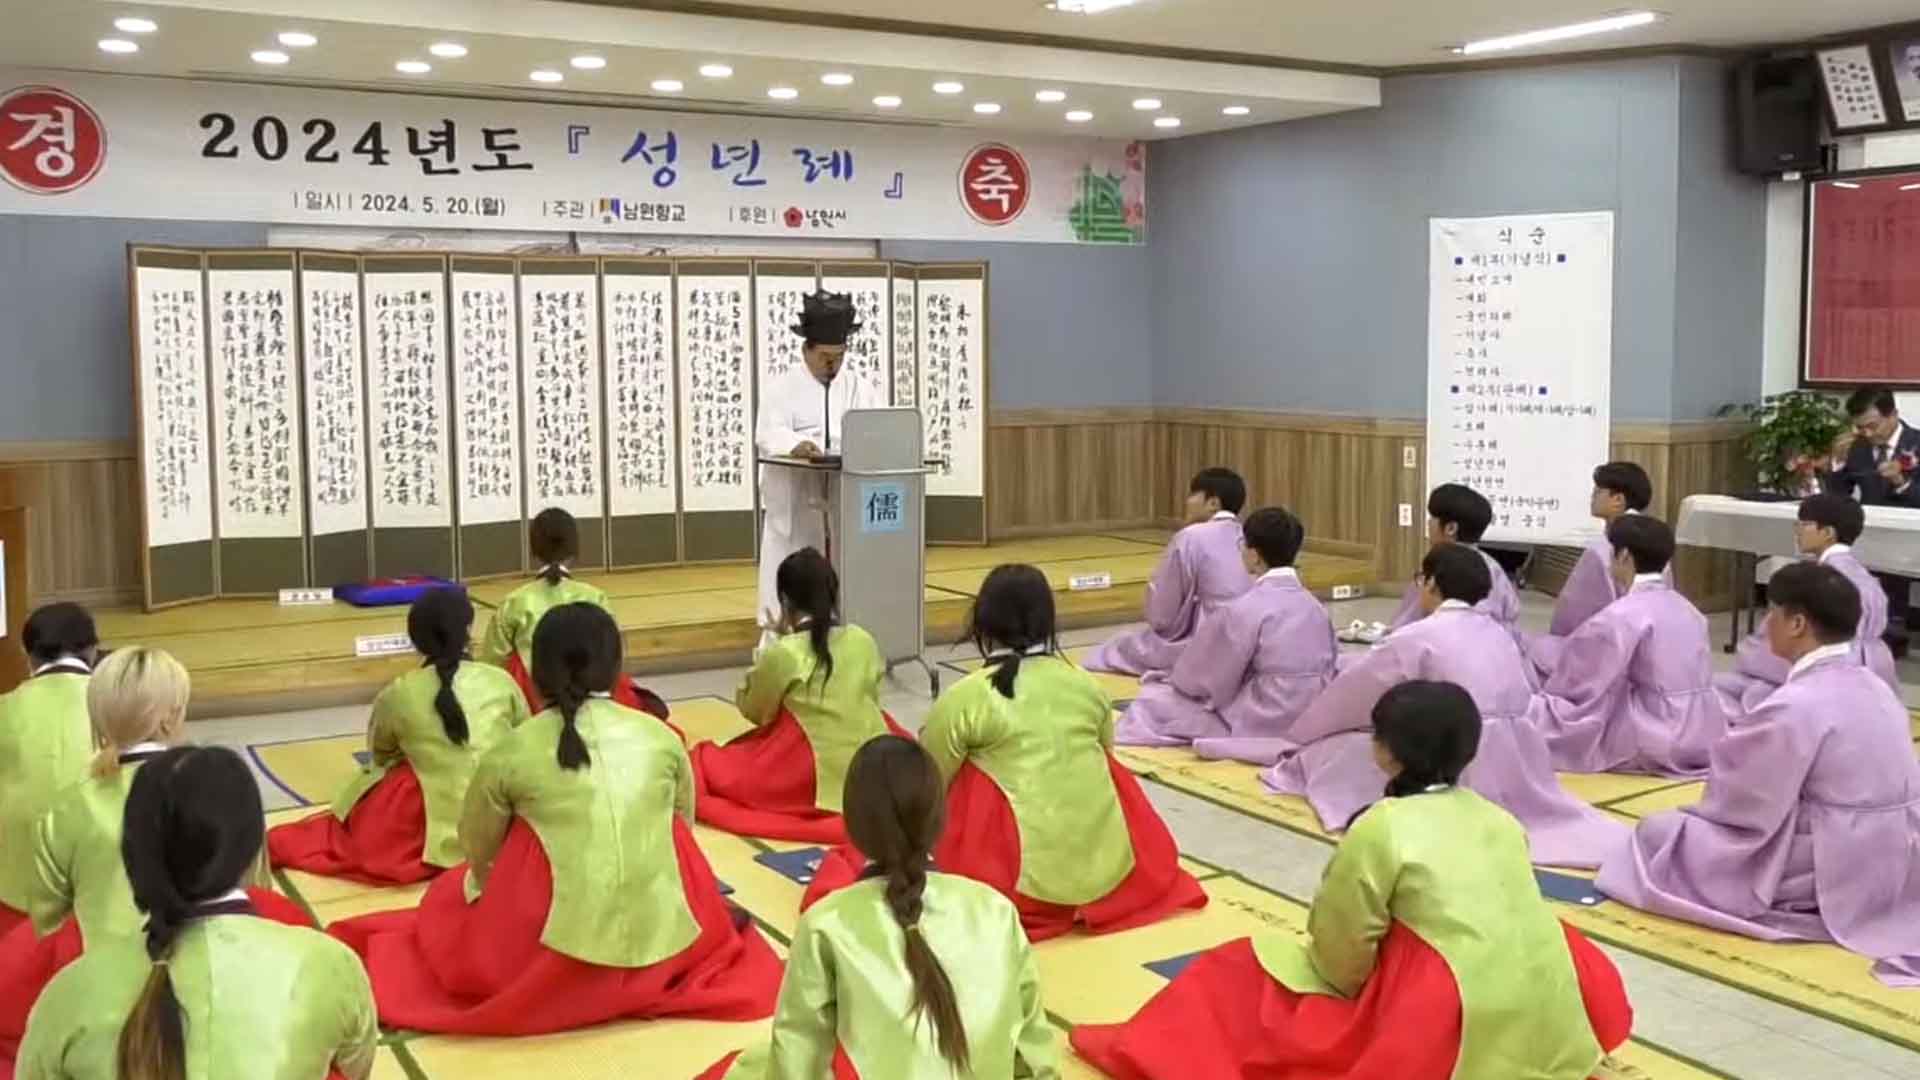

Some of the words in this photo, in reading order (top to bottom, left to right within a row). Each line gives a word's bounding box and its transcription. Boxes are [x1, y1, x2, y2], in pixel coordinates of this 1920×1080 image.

[7, 106, 76, 178] 경
[198, 111, 535, 176] 2024년도
[305, 190, 341, 211] 일시
[969, 156, 1020, 214] 축
[552, 200, 585, 220] 주관
[622, 202, 687, 222] 남원향교
[865, 491, 899, 524] 儒
